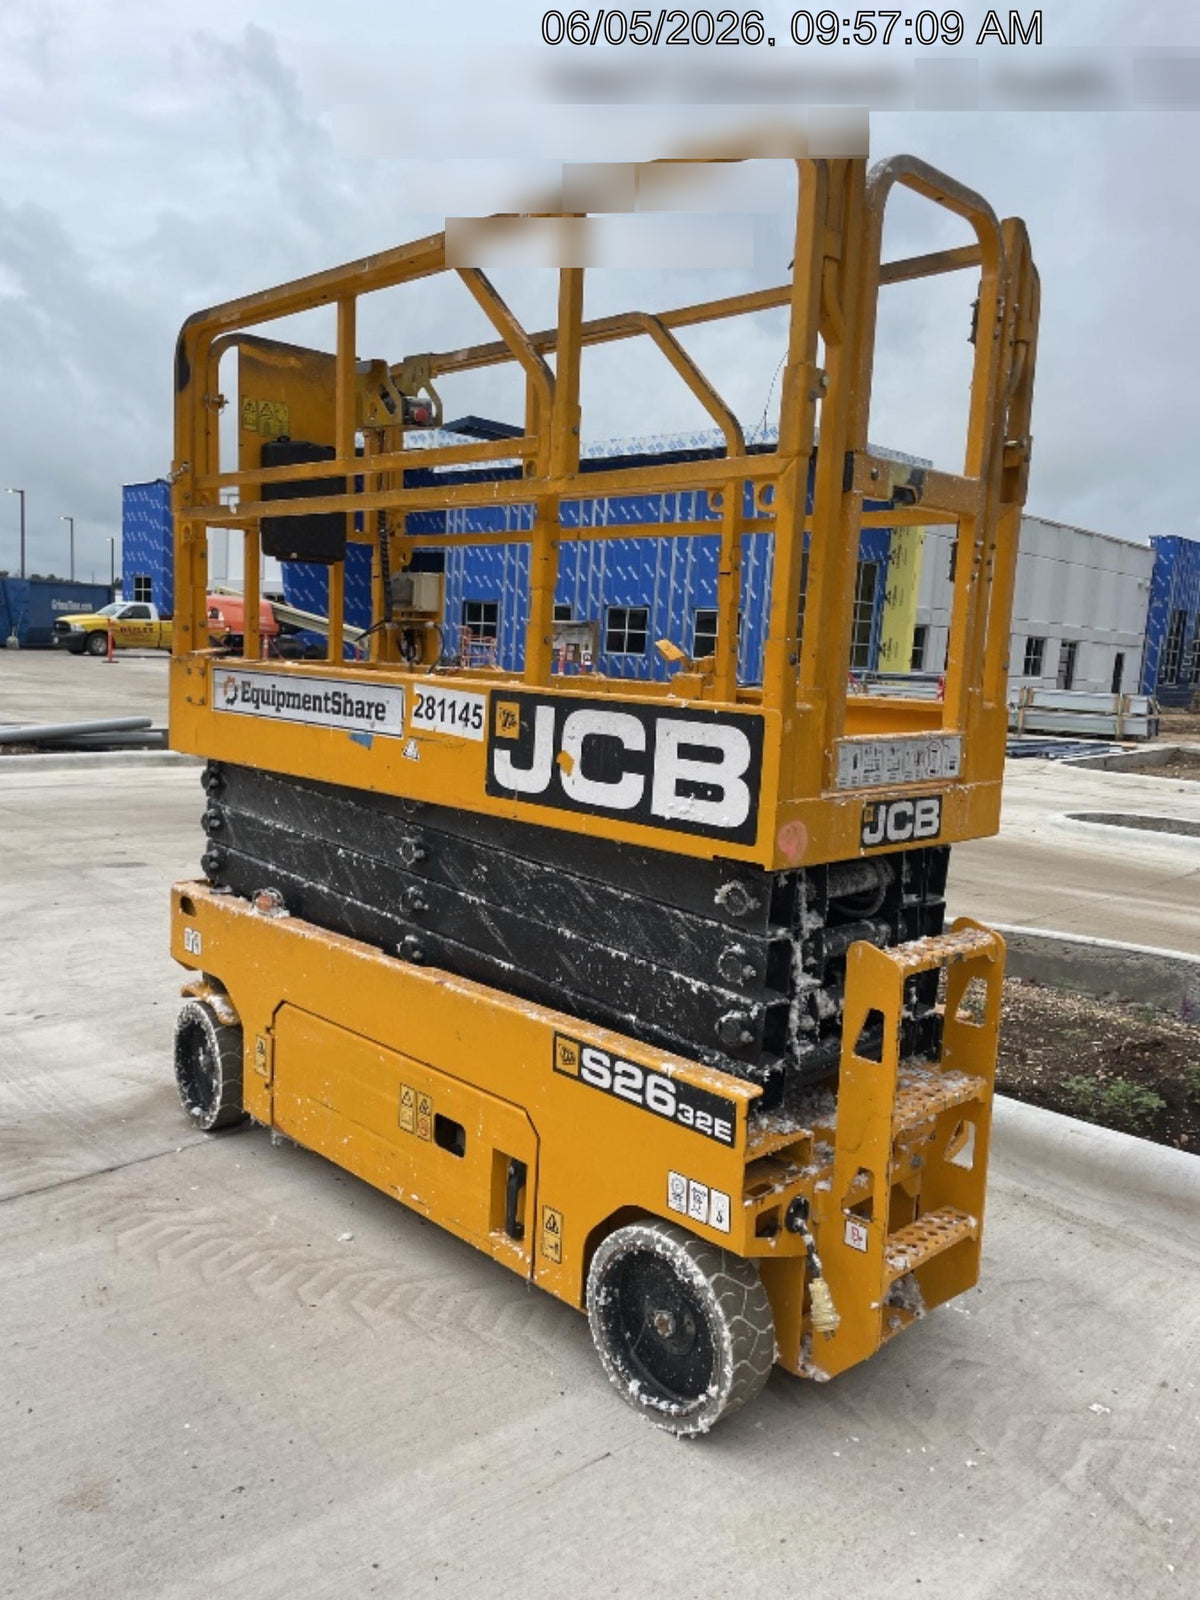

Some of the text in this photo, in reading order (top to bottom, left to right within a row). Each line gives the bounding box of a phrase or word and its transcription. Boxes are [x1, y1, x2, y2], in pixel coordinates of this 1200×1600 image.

[240, 680, 386, 721] EquipmentShare
[413, 693, 483, 729] 281145
[493, 705, 751, 828] JCB
[862, 799, 940, 845] JCB
